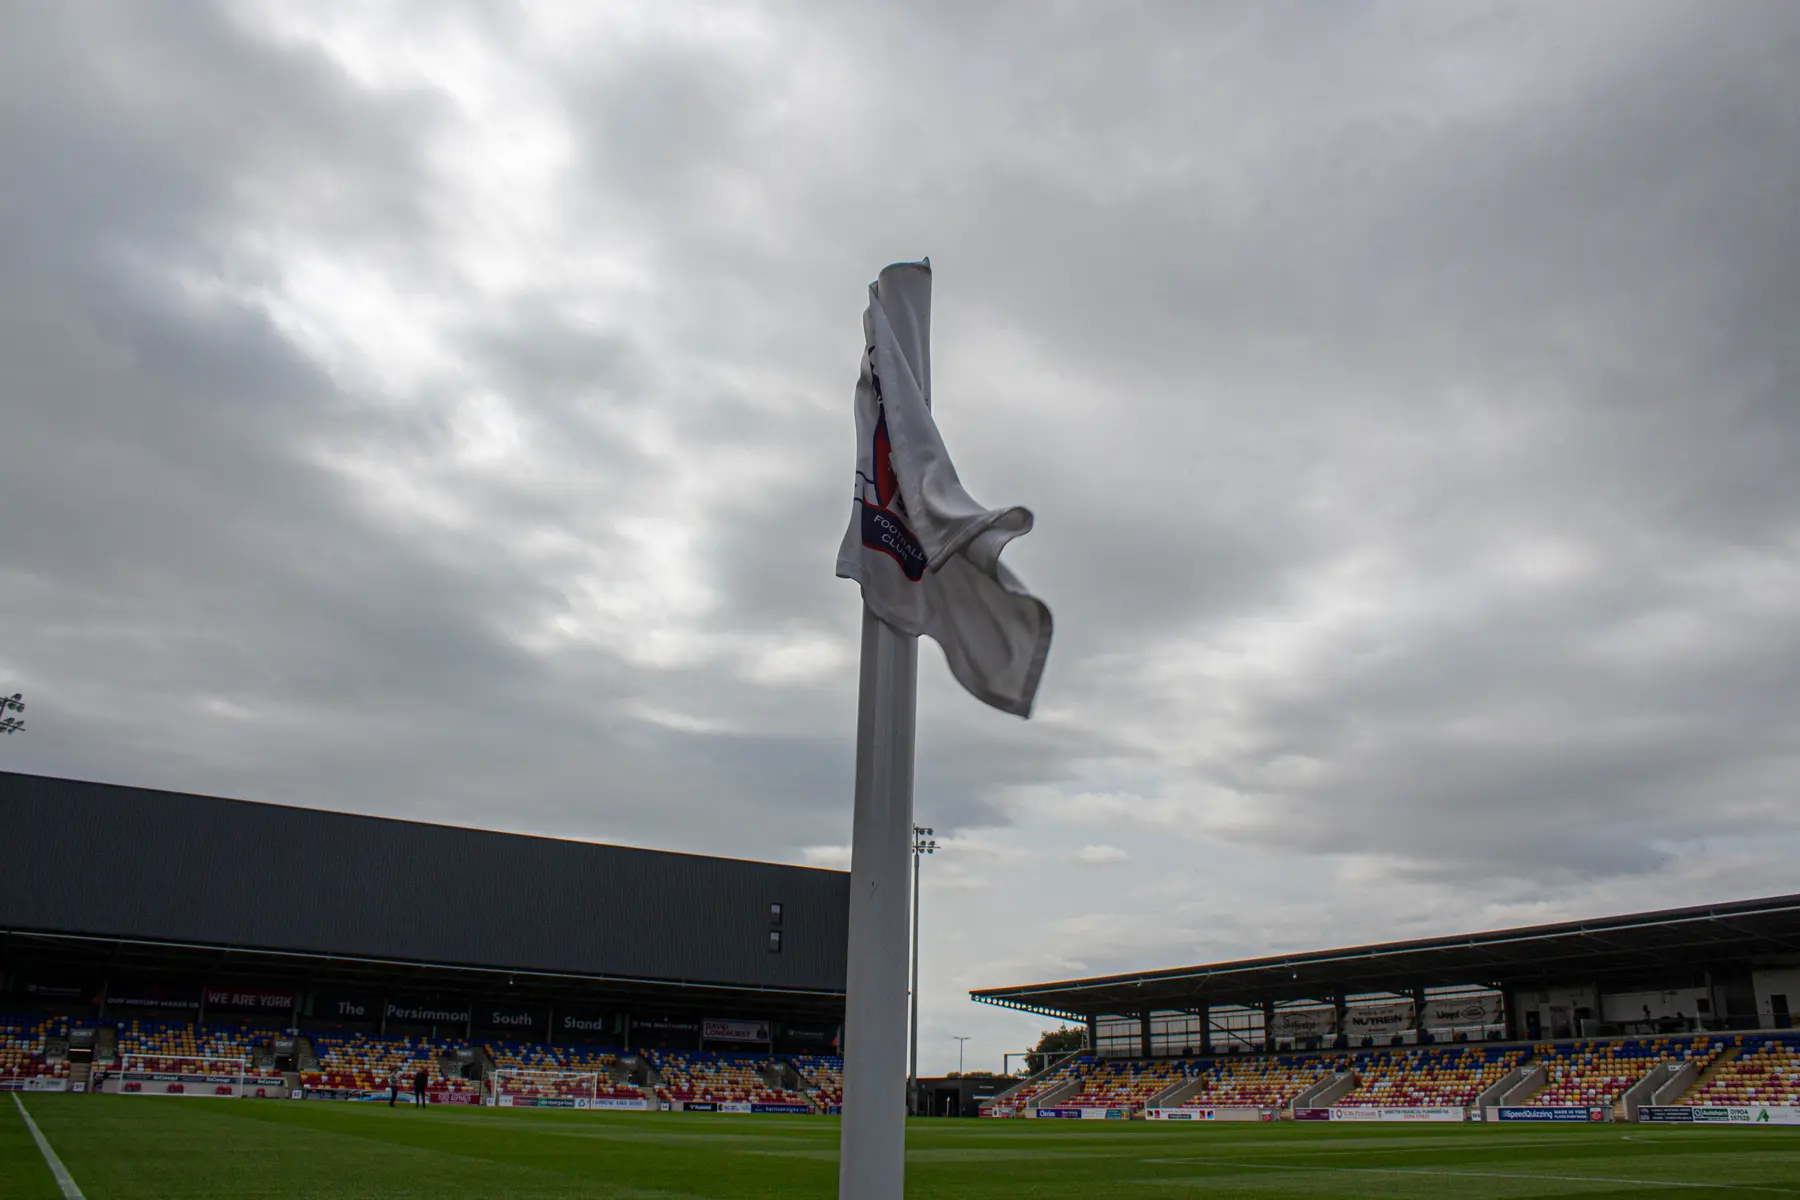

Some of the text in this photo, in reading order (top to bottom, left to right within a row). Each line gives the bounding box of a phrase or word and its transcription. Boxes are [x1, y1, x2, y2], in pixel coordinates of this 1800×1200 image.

[874, 514, 923, 561] FOOTBALL
[881, 533, 908, 560] CLUB
[208, 991, 292, 1008] WE ARE YORK
[338, 1001, 365, 1015] The
[387, 1004, 468, 1021] Persimmon
[492, 1012, 532, 1026] South
[564, 1016, 602, 1030] Stand
[1507, 1110, 1553, 1119] SpeedQuizzing
